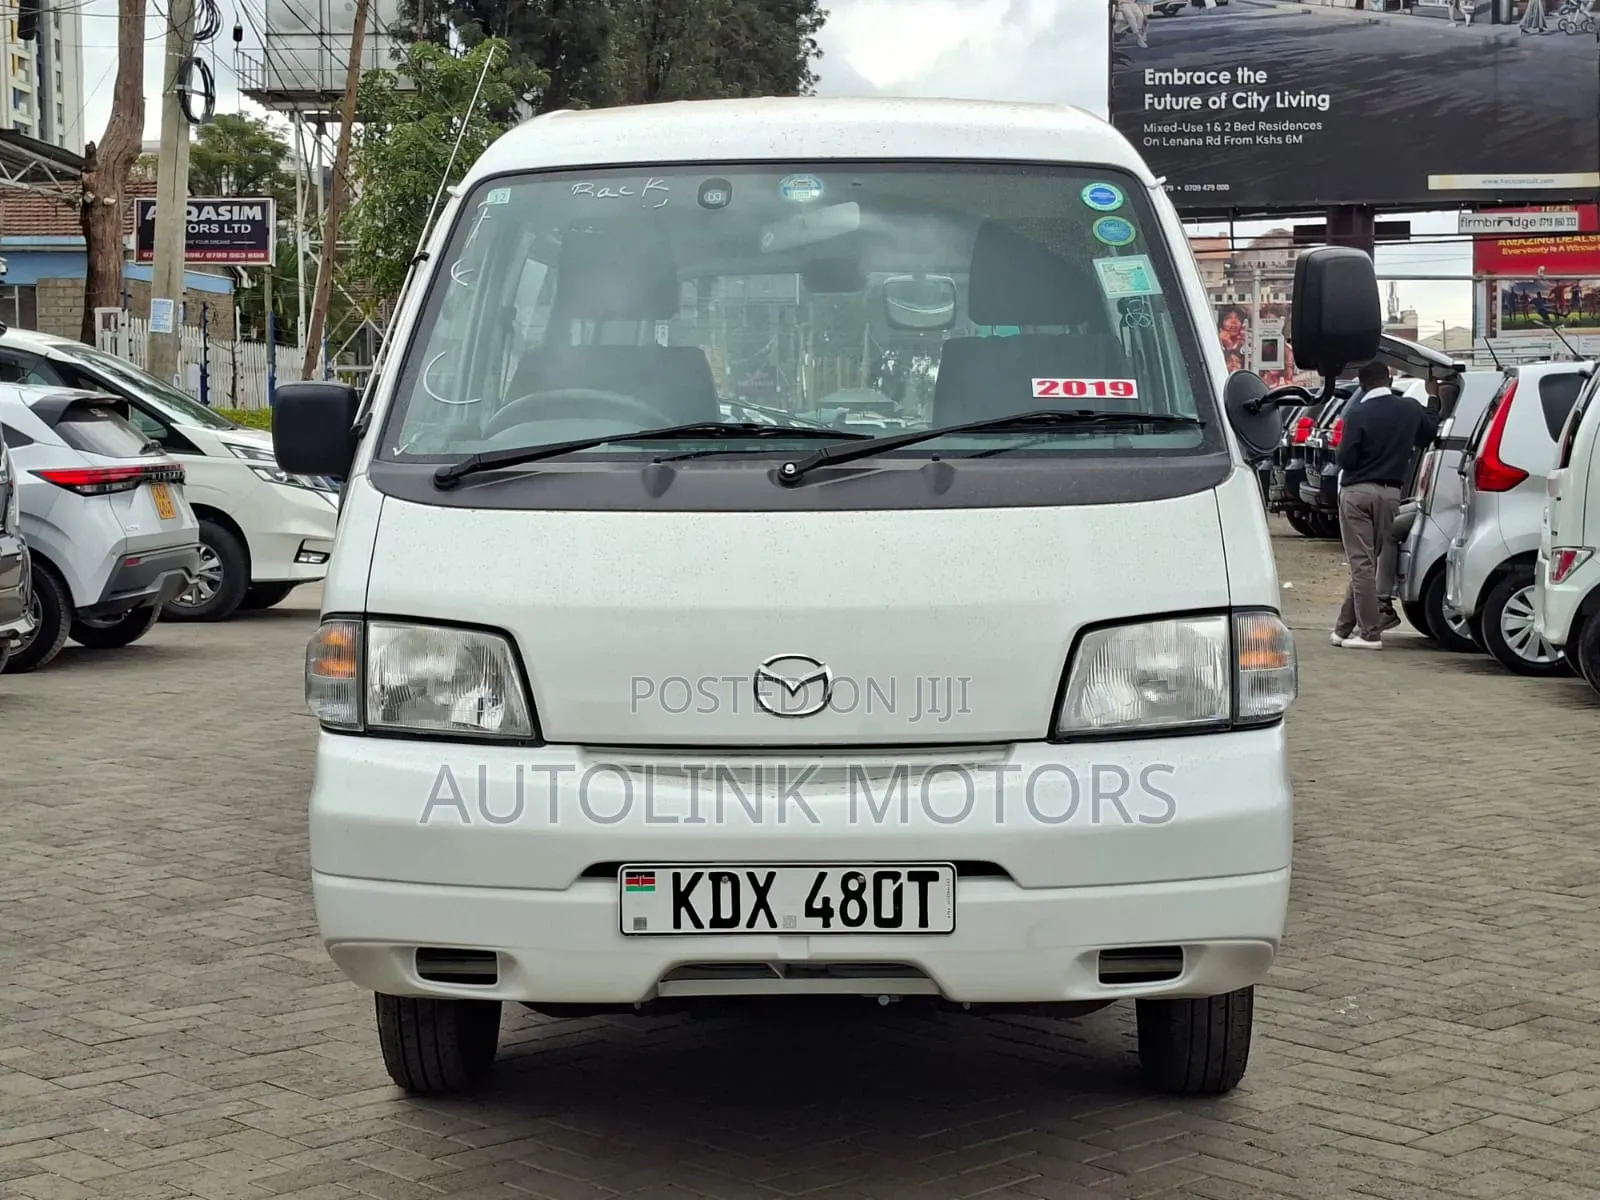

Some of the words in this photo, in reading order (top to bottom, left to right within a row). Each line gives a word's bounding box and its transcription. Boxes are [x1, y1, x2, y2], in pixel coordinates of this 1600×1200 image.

[1144, 68, 1231, 85] Embrace
[1237, 66, 1268, 84] the
[1144, 93, 1202, 110] Future
[1208, 92, 1227, 110] of
[1232, 91, 1270, 112] City
[1276, 90, 1330, 111] Living
[1143, 122, 1204, 133] Mixed-Use
[1206, 123, 1211, 132] 1
[1213, 122, 1222, 132] &
[1224, 122, 1231, 132] 2
[1234, 121, 1255, 132] Bed
[1258, 120, 1323, 131] Residences
[1143, 137, 1160, 146] On
[1162, 136, 1203, 146] Lenana
[1206, 135, 1221, 146] Rd
[1224, 136, 1253, 145] From
[1255, 134, 1283, 145] Kshs
[1285, 134, 1303, 144] 6M
[224, 223, 252, 234] LTD
[1037, 380, 1134, 397] 2019
[672, 871, 778, 929] KDX
[804, 871, 940, 929] 480T
